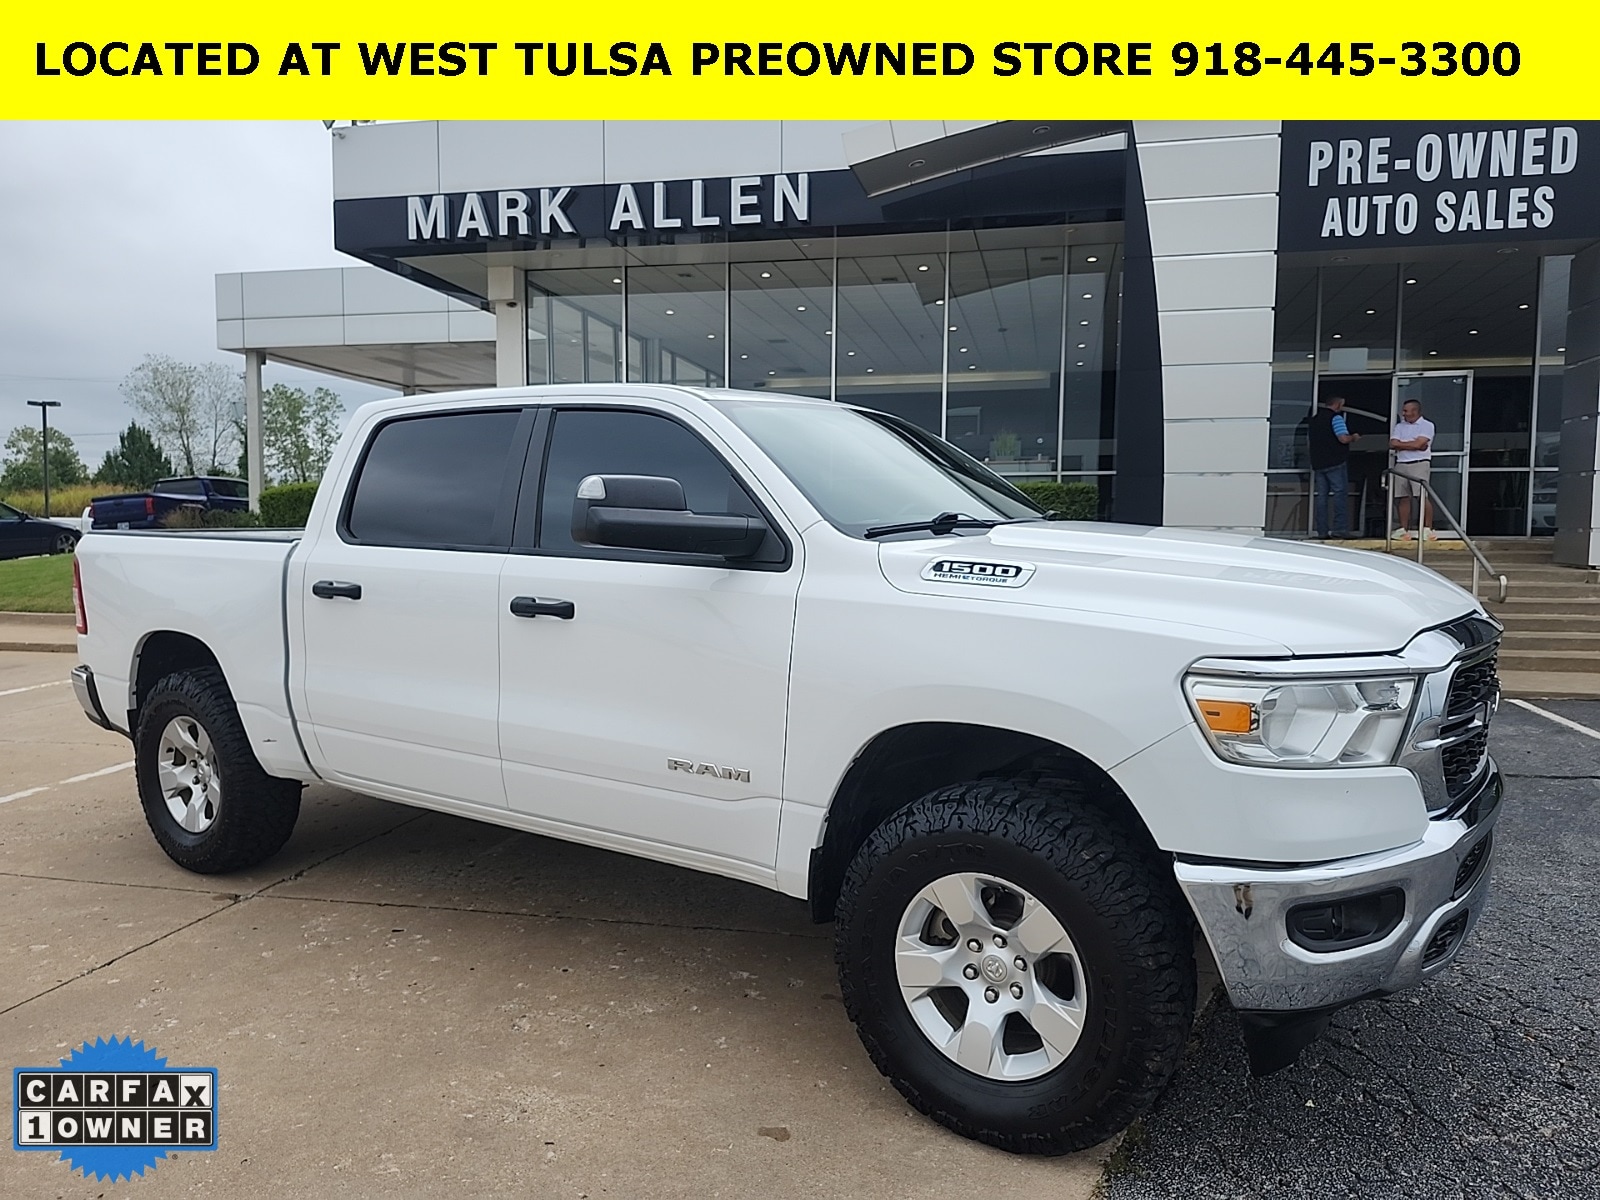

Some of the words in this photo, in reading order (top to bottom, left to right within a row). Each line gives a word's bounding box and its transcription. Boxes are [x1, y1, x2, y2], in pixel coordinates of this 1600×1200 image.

[1308, 126, 1579, 187] PRE-OWNED
[407, 186, 578, 241] MARK
[609, 172, 809, 231] ALLEN
[1321, 193, 1418, 237] AUTO
[1434, 185, 1555, 233] SALES
[940, 561, 1017, 577] 1500
[667, 757, 750, 783] RAM
